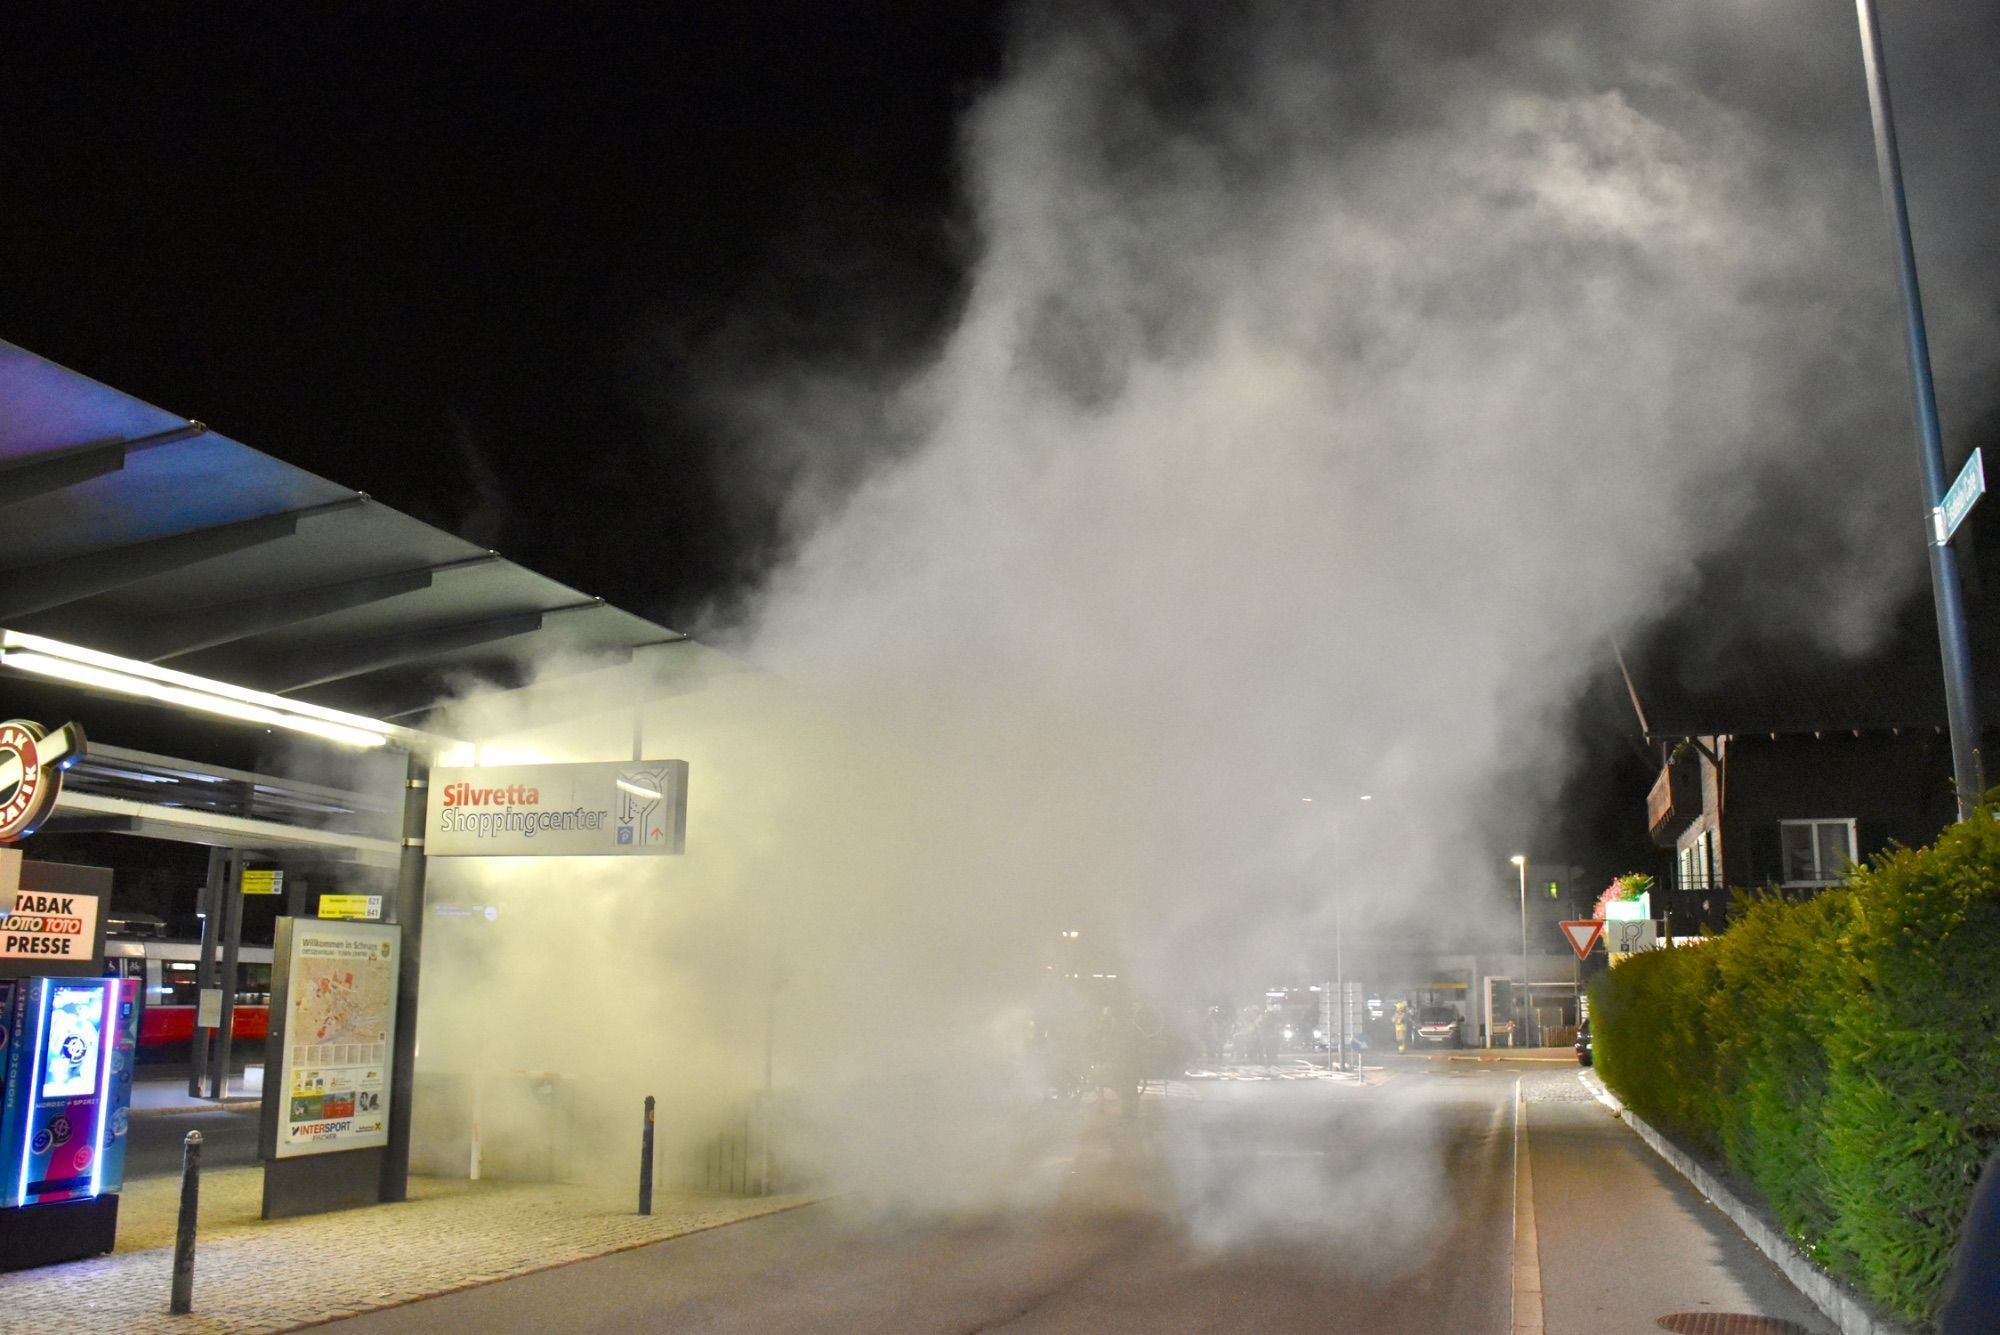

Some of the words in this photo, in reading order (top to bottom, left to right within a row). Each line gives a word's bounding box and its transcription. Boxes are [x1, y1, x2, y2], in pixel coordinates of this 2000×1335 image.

[443, 783, 540, 806] Silvretta
[441, 806, 608, 838] Shoppingcenter
[15, 895, 74, 915] TABAK
[0, 915, 43, 931] LOTTO
[45, 918, 81, 933] TOTO
[6, 935, 71, 954] PRESSE
[300, 1121, 351, 1135] INTERSPORT
